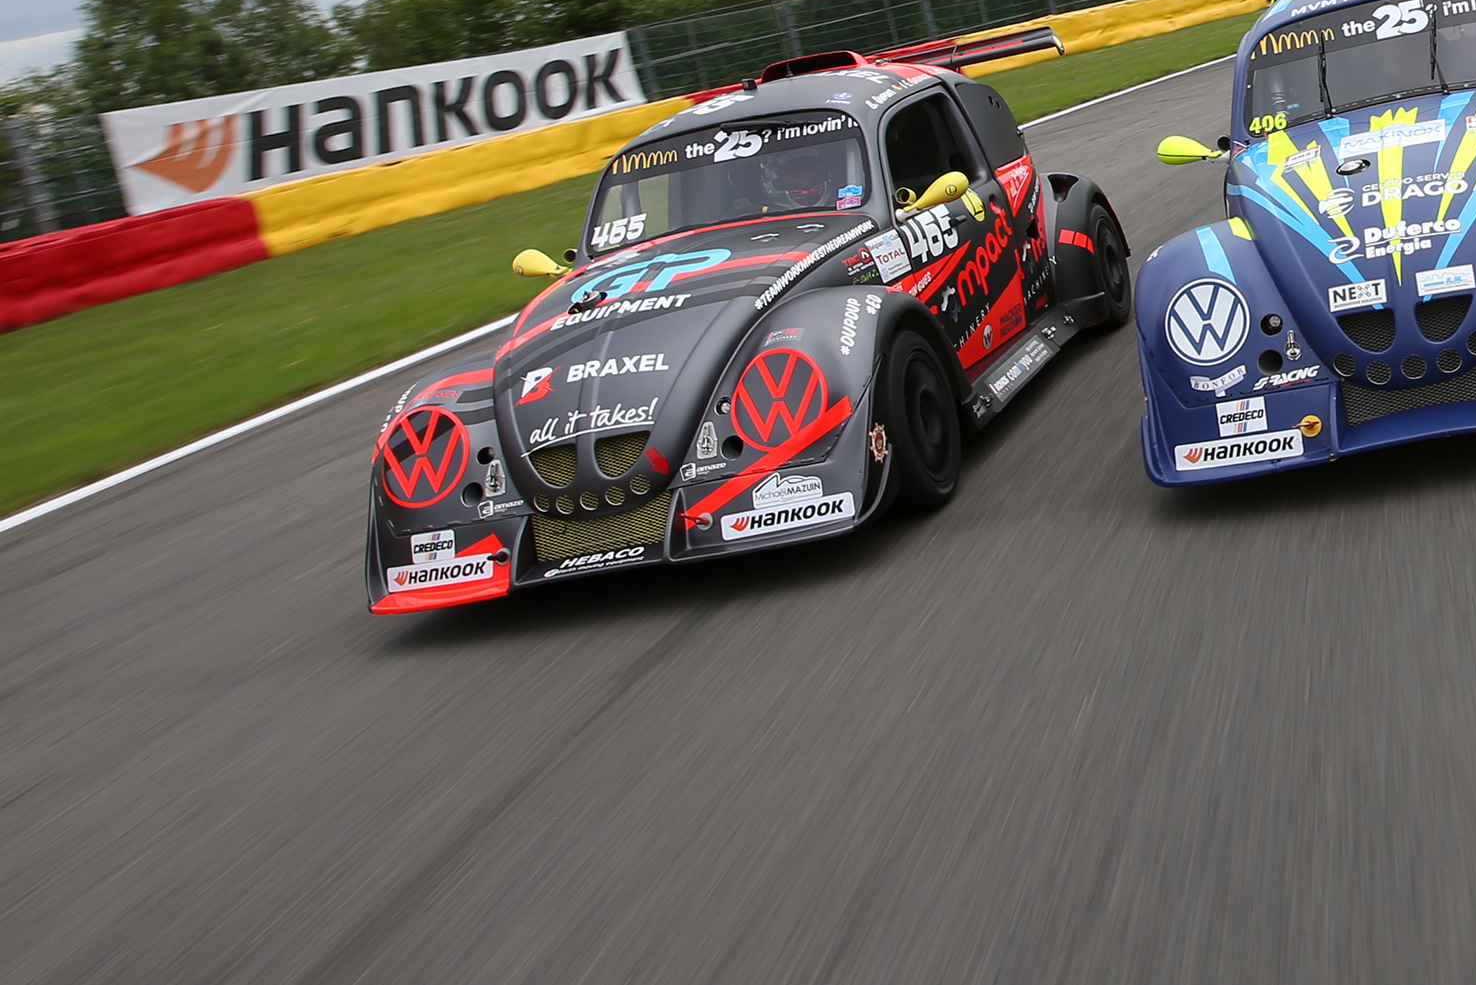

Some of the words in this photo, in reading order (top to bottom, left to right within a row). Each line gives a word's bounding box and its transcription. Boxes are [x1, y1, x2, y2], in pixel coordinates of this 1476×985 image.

[1341, 20, 1376, 37] the
[1442, 0, 1470, 16] i'm
[1248, 113, 1288, 134] 406
[685, 142, 715, 159] the
[1361, 179, 1469, 208] DRAGO
[590, 213, 648, 248] 465
[899, 203, 959, 264] 465
[1363, 218, 1462, 244] Duferco
[876, 248, 906, 266] TOTAL
[1365, 236, 1432, 259] Energia
[570, 248, 732, 303] GP
[1332, 282, 1381, 304] NEXT
[550, 293, 692, 332] EQUIPMENT
[566, 353, 669, 384] BRAXEL
[1193, 368, 1245, 390] BONFOR
[529, 417, 559, 445] all
[564, 409, 587, 434] it
[589, 396, 659, 427] takes!
[1219, 409, 1264, 425] CREDECO
[413, 539, 453, 555] CREDECO
[559, 546, 645, 569] HEBACO
